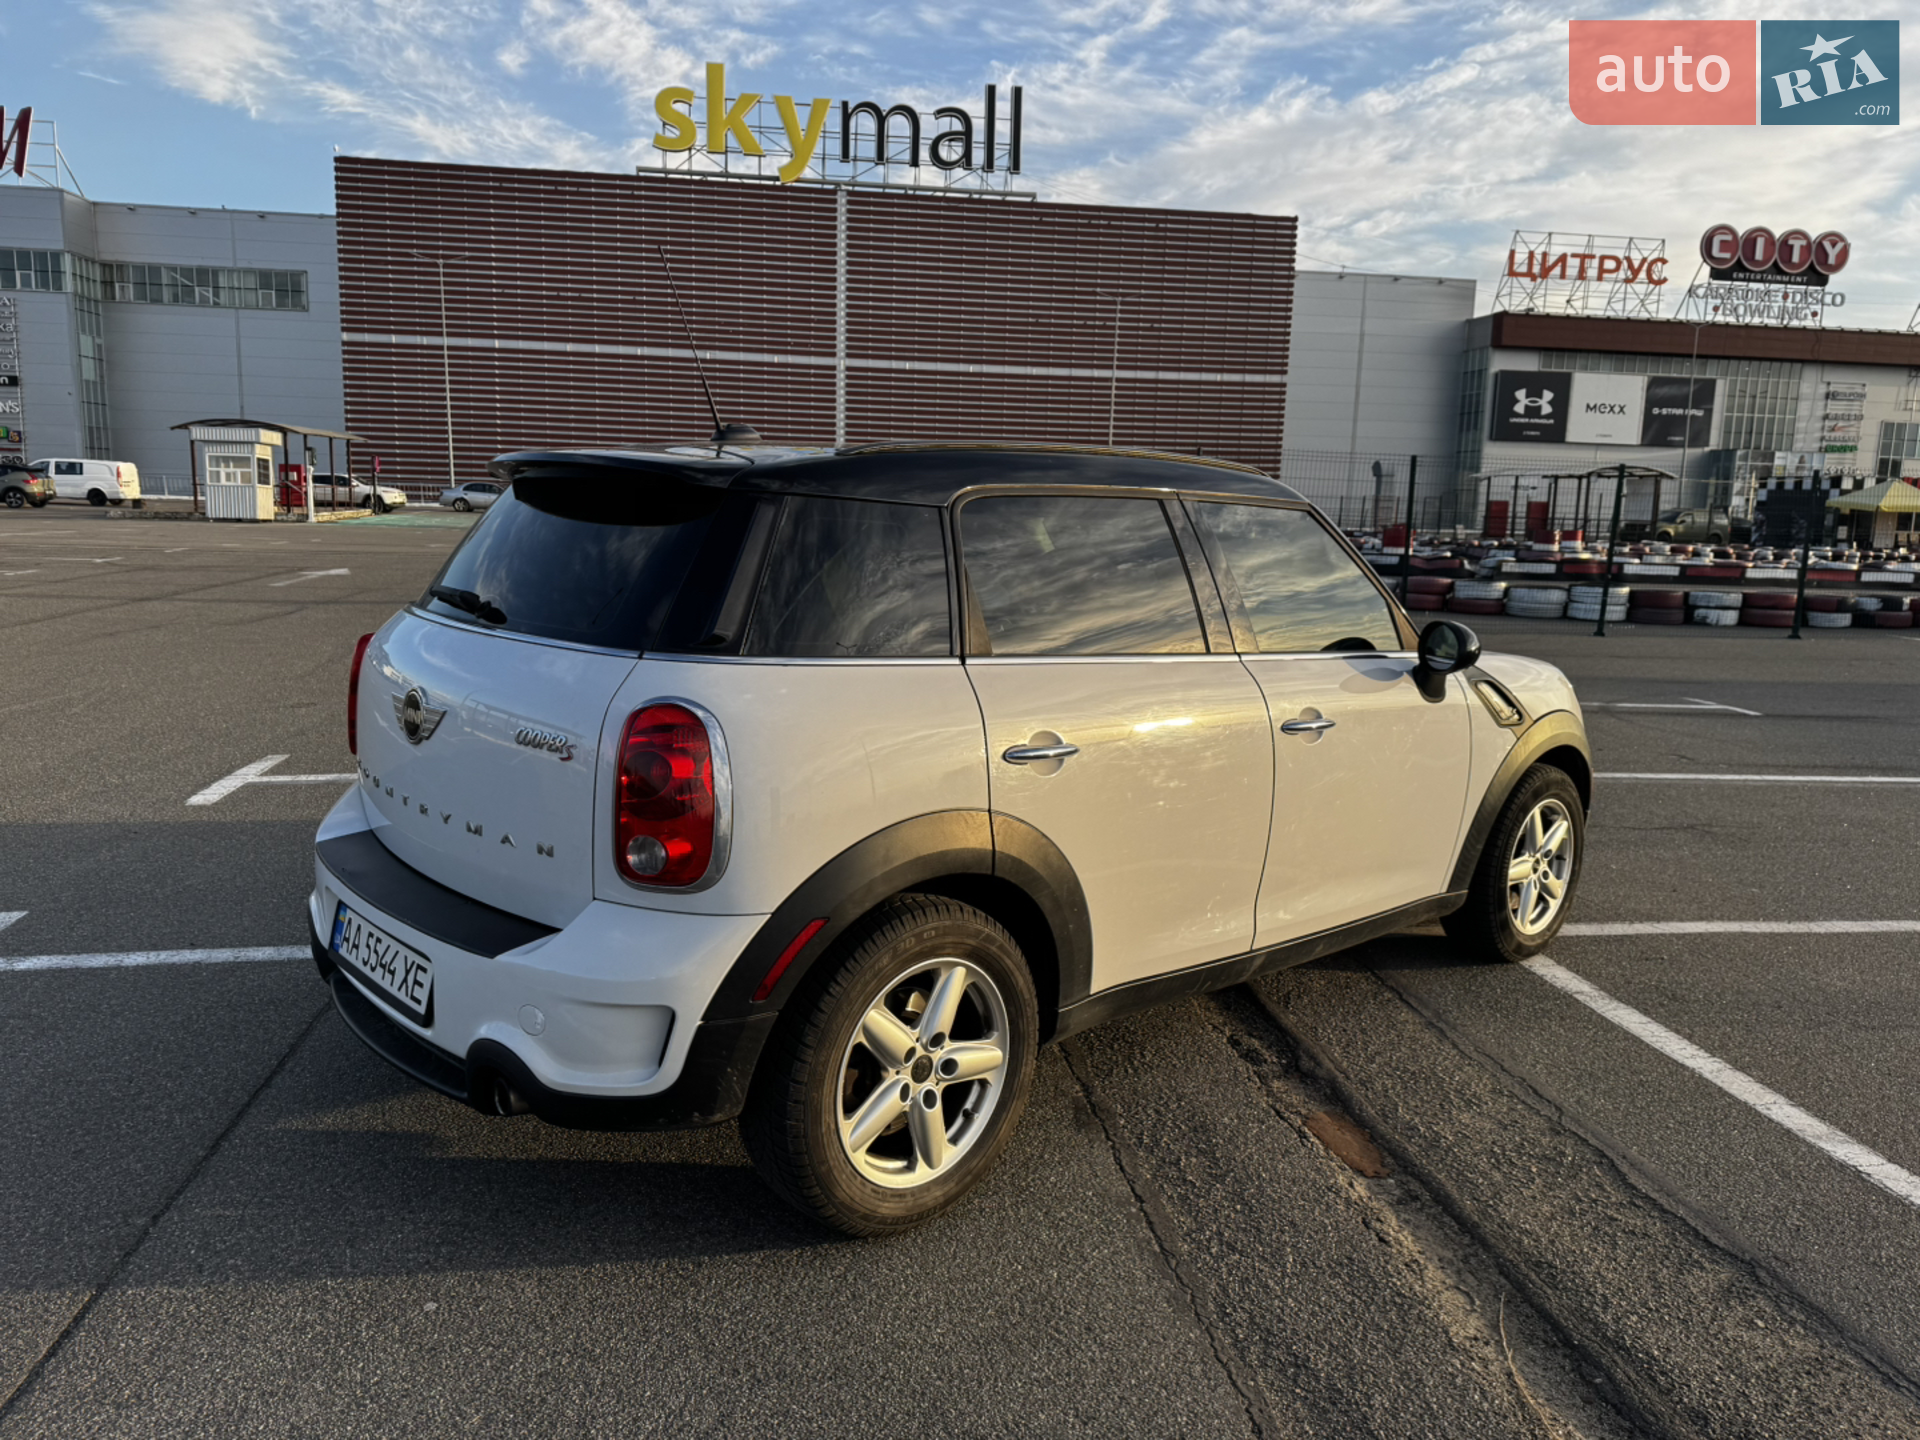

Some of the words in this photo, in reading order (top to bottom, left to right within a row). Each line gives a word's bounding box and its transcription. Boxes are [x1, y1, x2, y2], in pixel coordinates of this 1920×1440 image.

[1711, 234, 1845, 265] CITY
[1508, 249, 1669, 286] ЦИТРУС
[1732, 271, 1808, 283] ENTERTAINMENT
[1689, 283, 1780, 303] KARAOKE
[1791, 290, 1846, 308] DISCO
[1722, 302, 1809, 321] BOWLING
[1652, 407, 1684, 416] G-STAR
[514, 727, 568, 754] COOPER
[340, 916, 362, 961] AA
[362, 930, 400, 988] 5544
[397, 954, 428, 1007] XE
